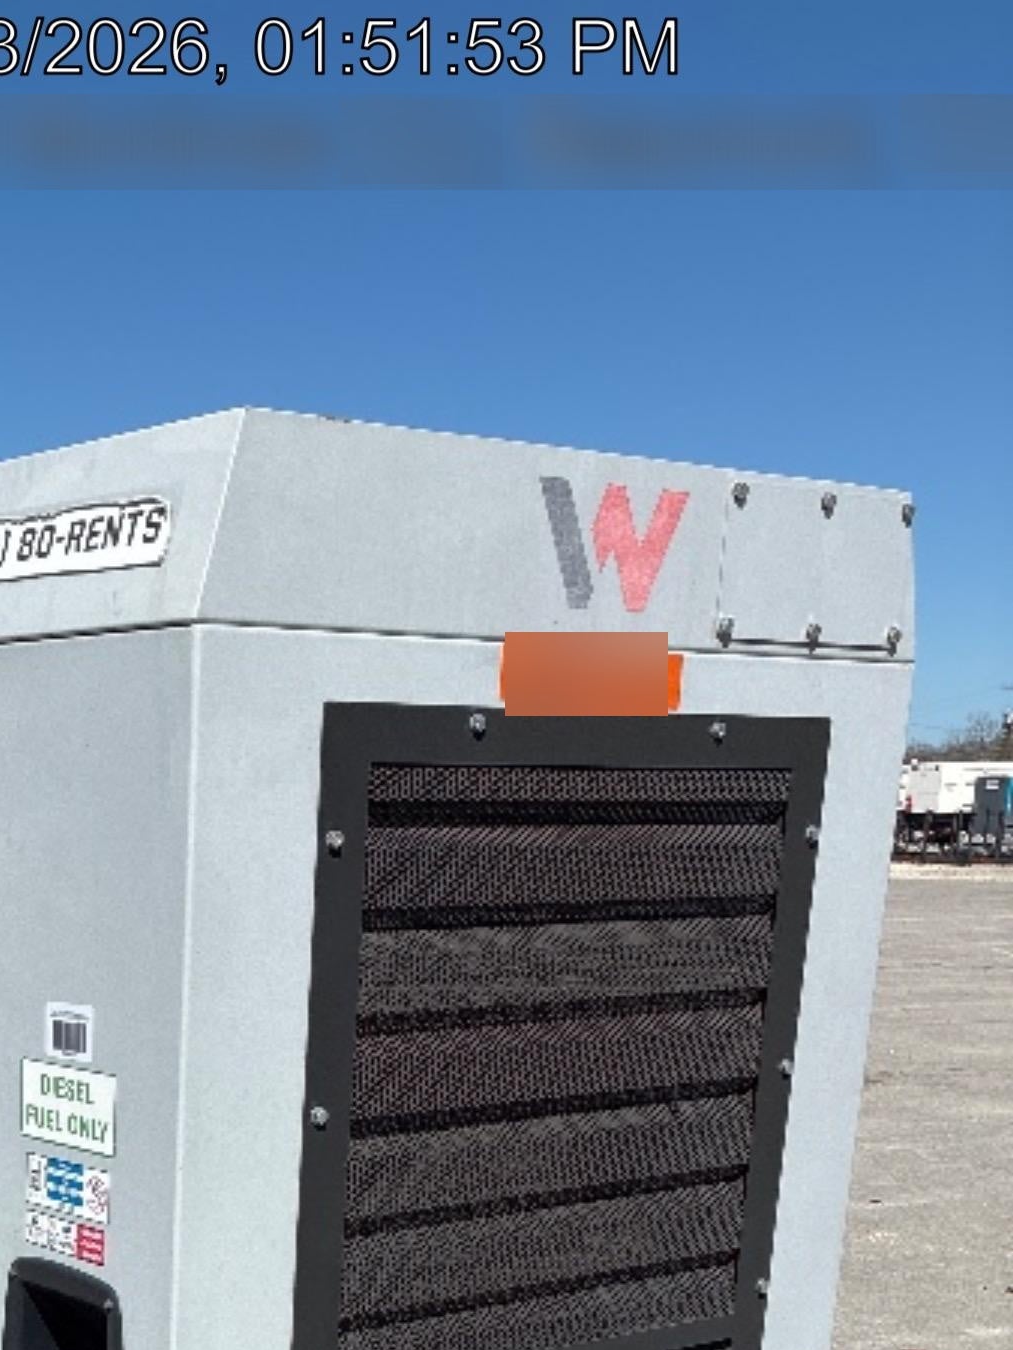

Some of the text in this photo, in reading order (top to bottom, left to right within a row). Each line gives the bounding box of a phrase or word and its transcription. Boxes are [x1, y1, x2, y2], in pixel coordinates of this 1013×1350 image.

[16, 505, 167, 562] 80-RENTS
[40, 1072, 95, 1105] DIESEL
[25, 1103, 109, 1144] FUEL ONLY
